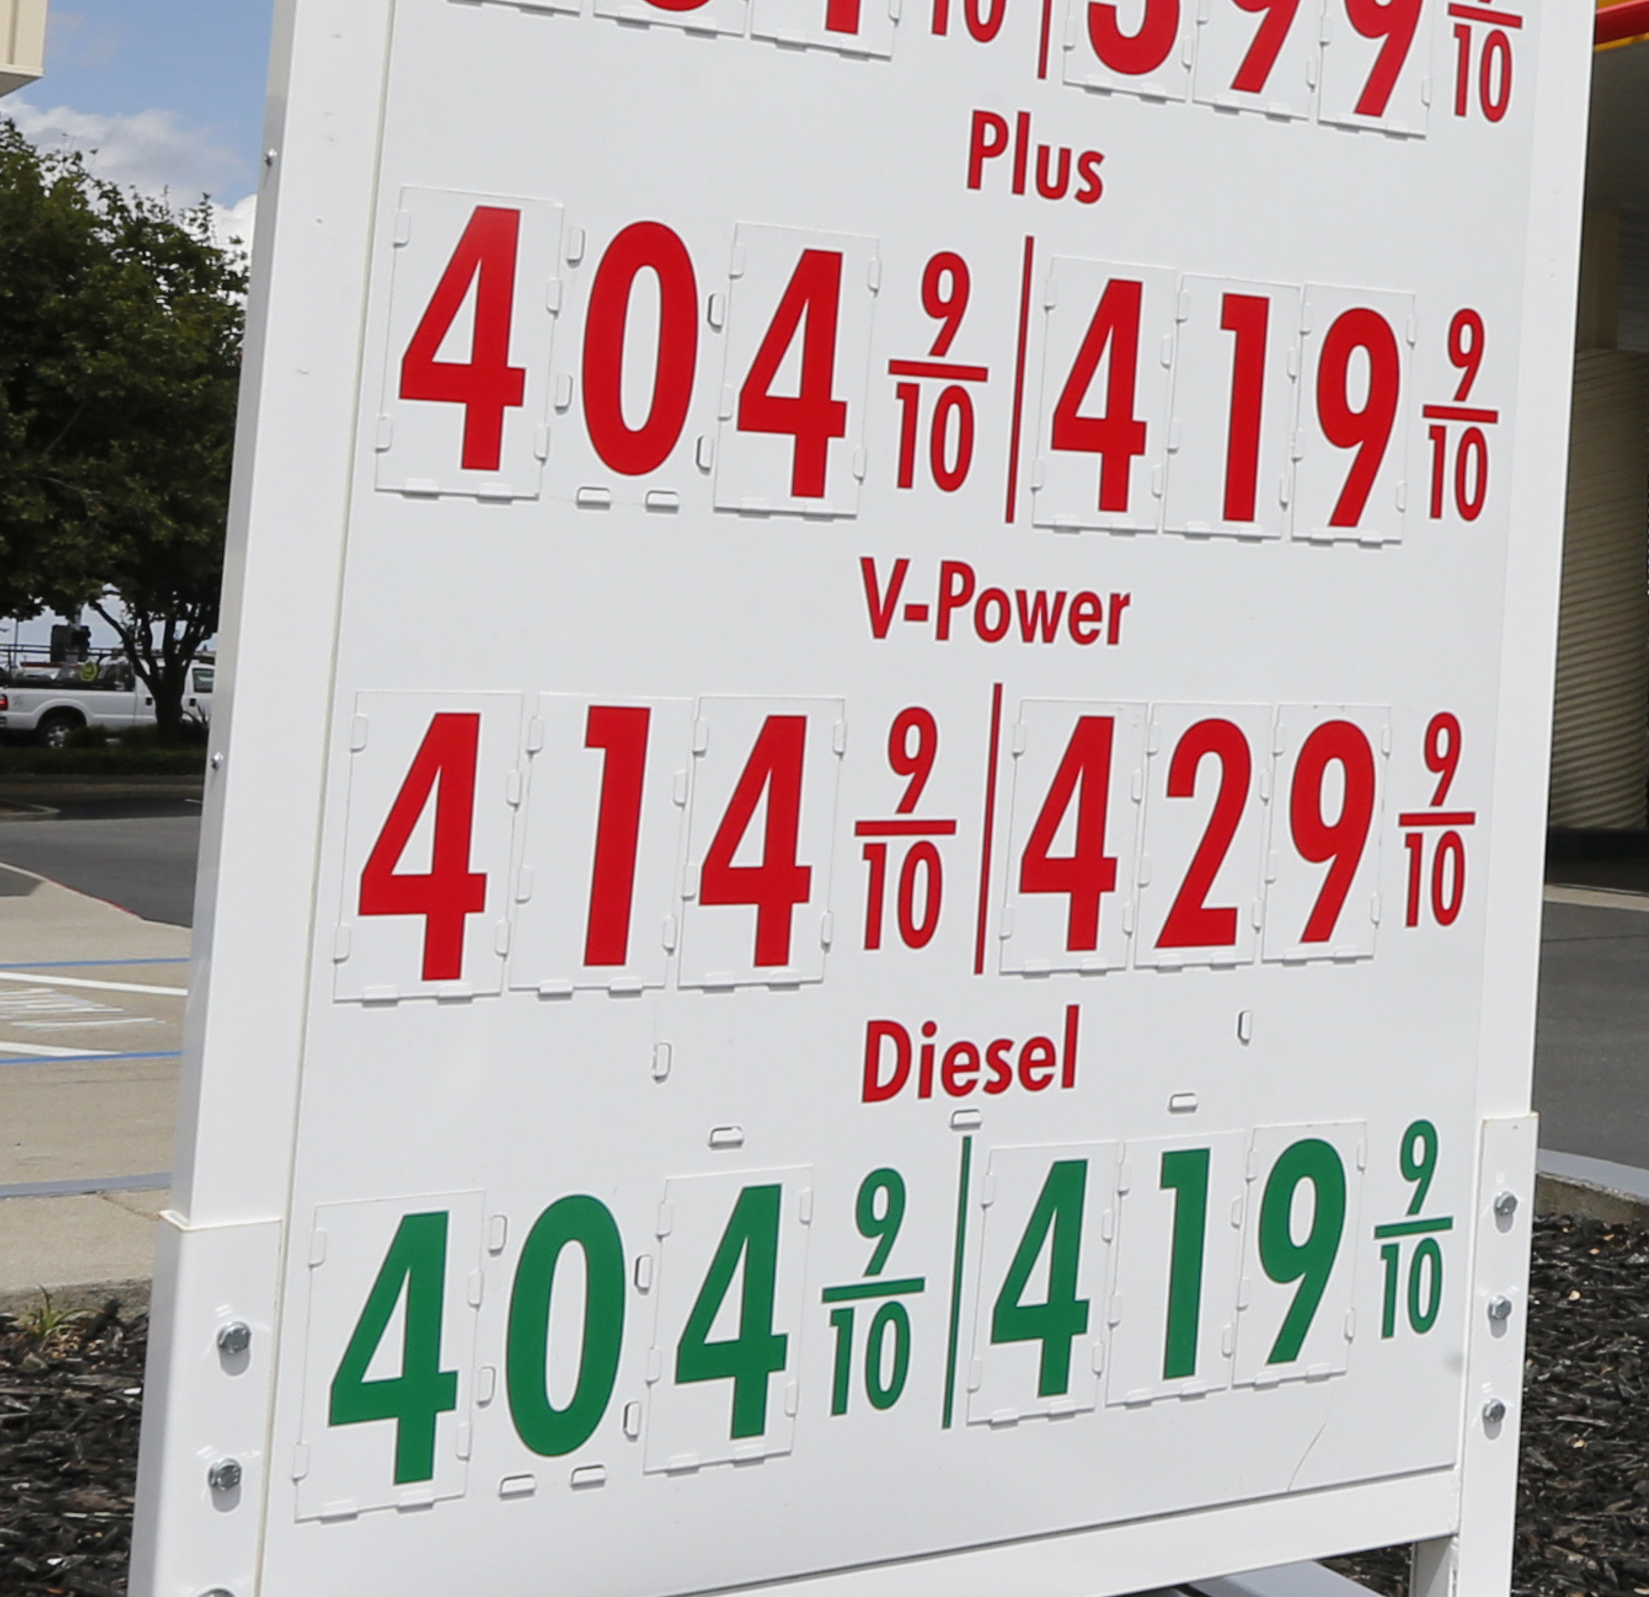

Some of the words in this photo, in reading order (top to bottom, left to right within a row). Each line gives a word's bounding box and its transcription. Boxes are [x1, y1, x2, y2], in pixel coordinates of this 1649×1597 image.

[967, 109, 1105, 205] Plus
[398, 205, 848, 499] 404
[1051, 277, 1401, 529] 419
[860, 556, 1131, 647] V-Power
[358, 711, 813, 983] 414
[1019, 715, 1377, 953] 429
[862, 1003, 1080, 1104] Diesel
[330, 1184, 788, 1485] 404
[992, 1138, 1347, 1397] 419
